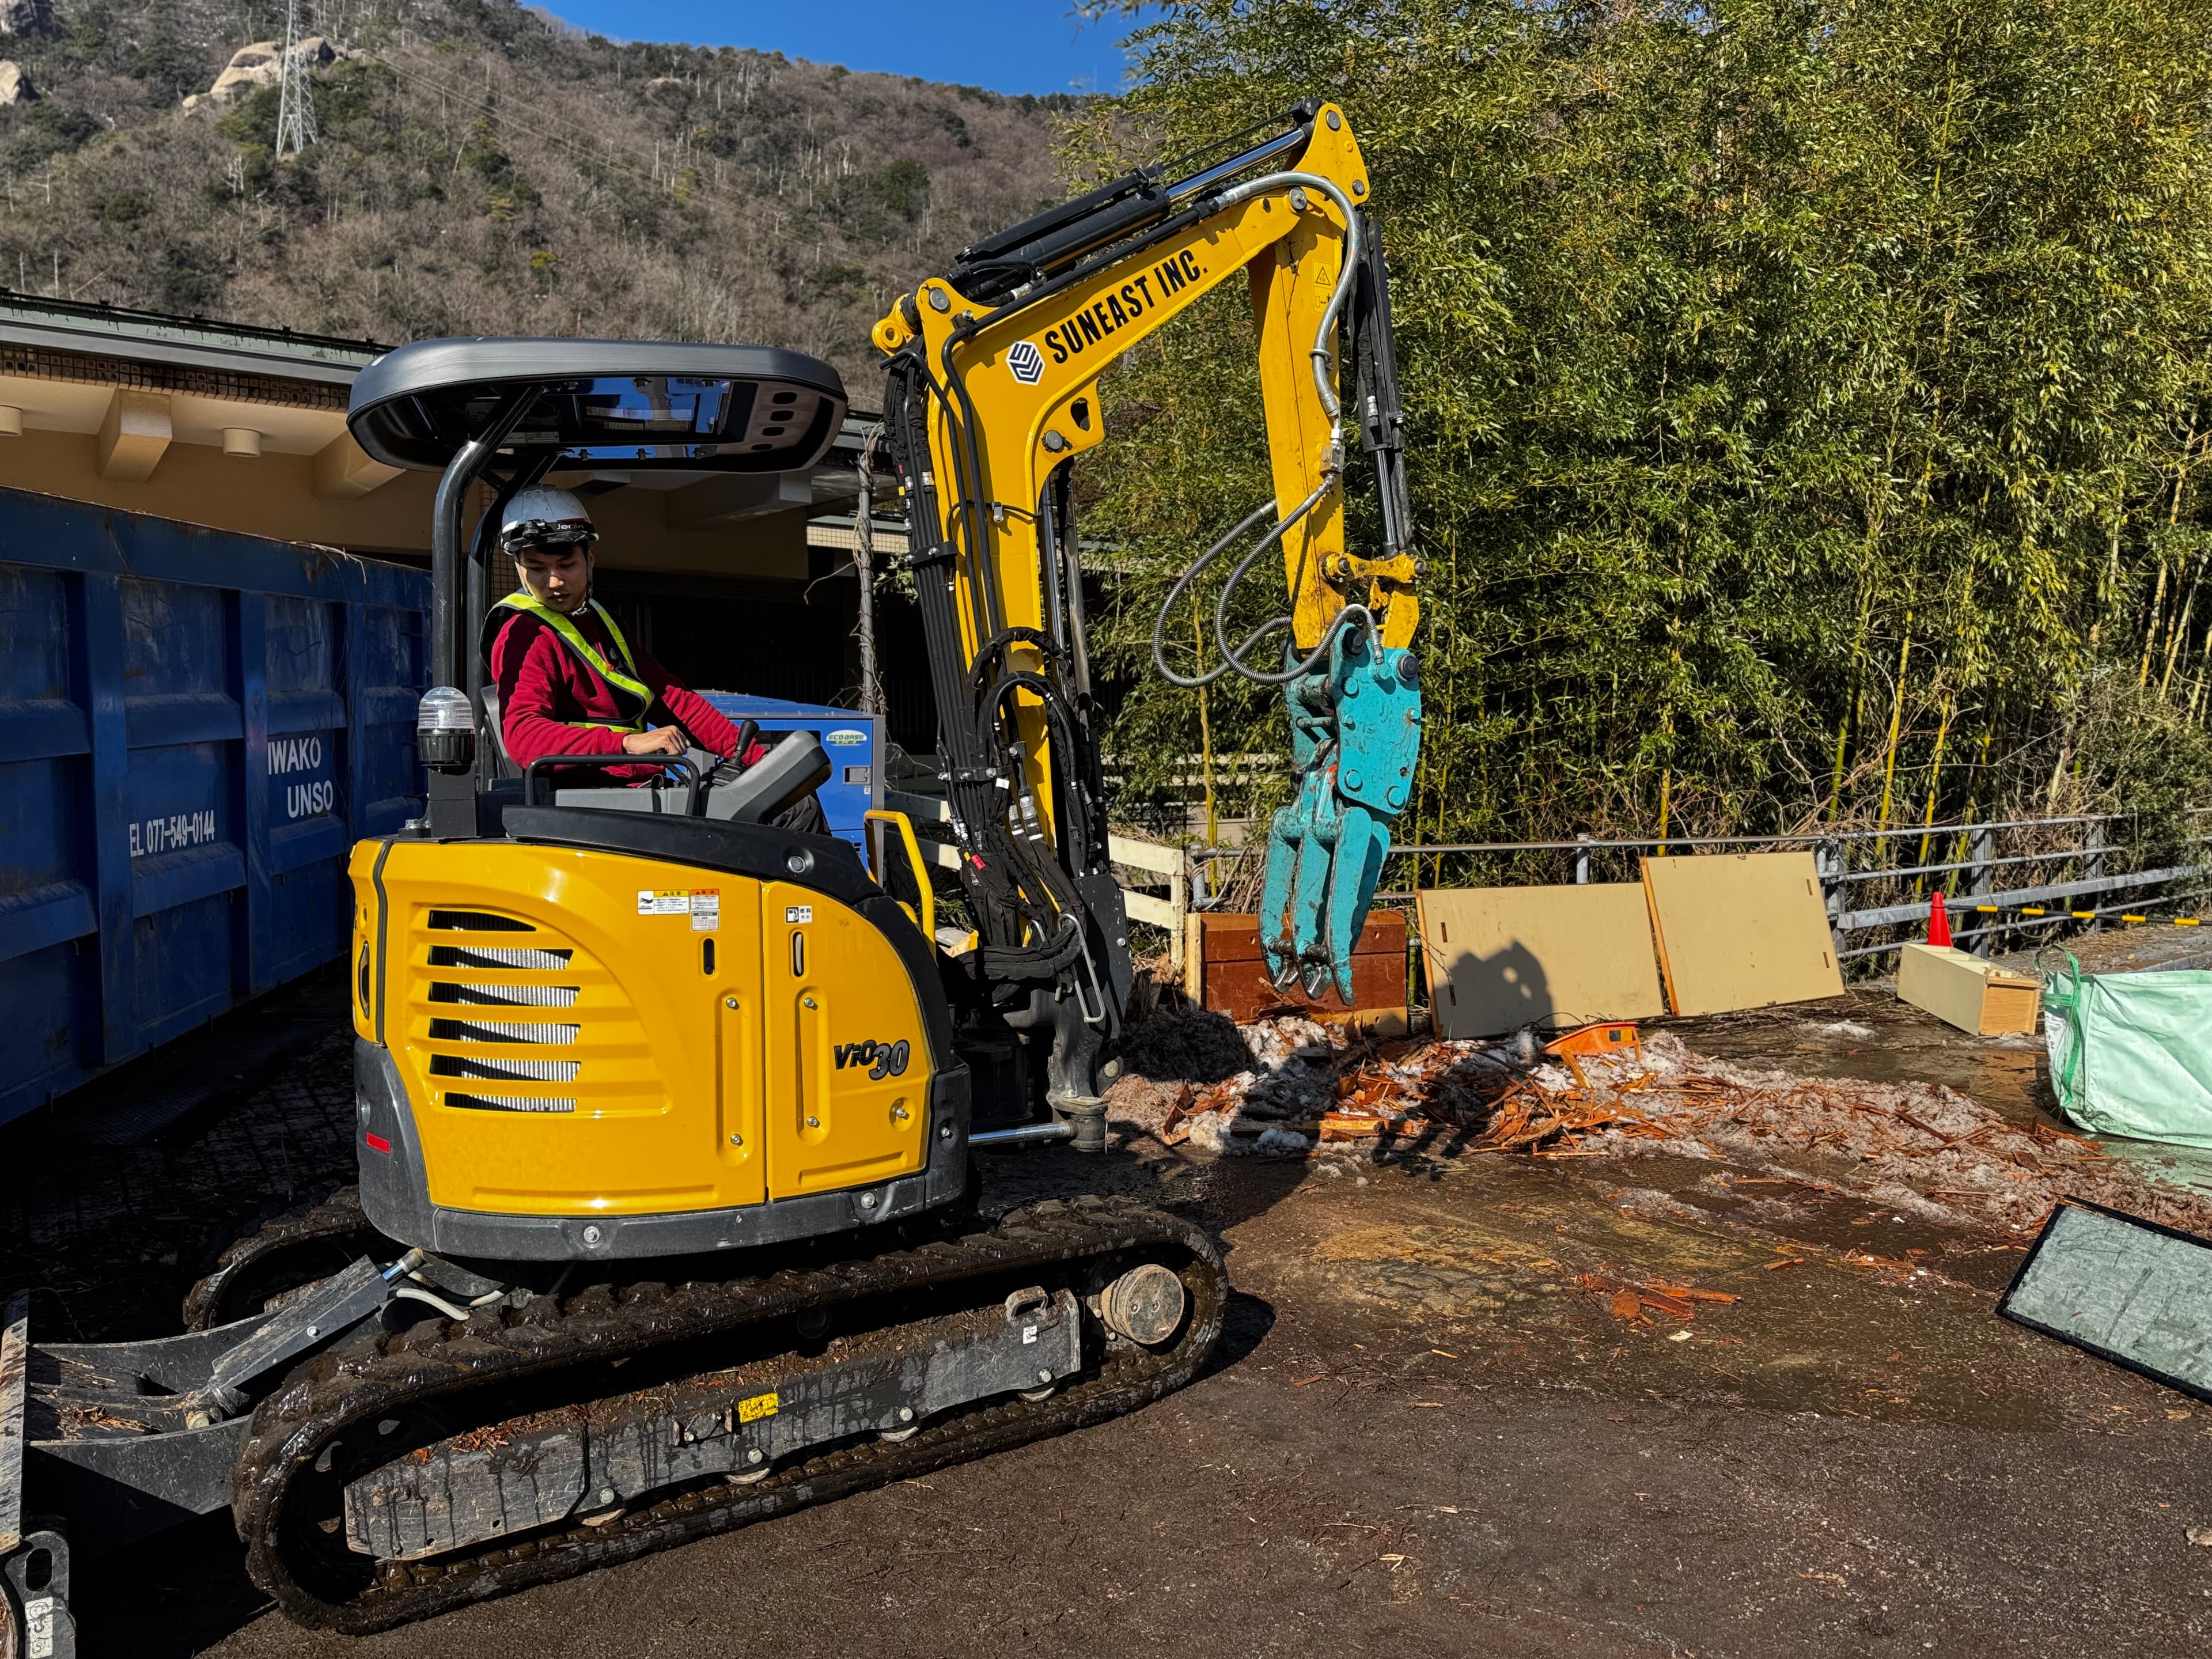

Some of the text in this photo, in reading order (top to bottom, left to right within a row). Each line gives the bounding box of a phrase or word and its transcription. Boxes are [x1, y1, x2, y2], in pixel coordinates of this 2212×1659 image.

[1046, 249, 1209, 364] SUNEAST INC.
[268, 737, 321, 775] IWAKO
[287, 779, 333, 818] UNSO
[146, 809, 215, 854] 077-549-0144
